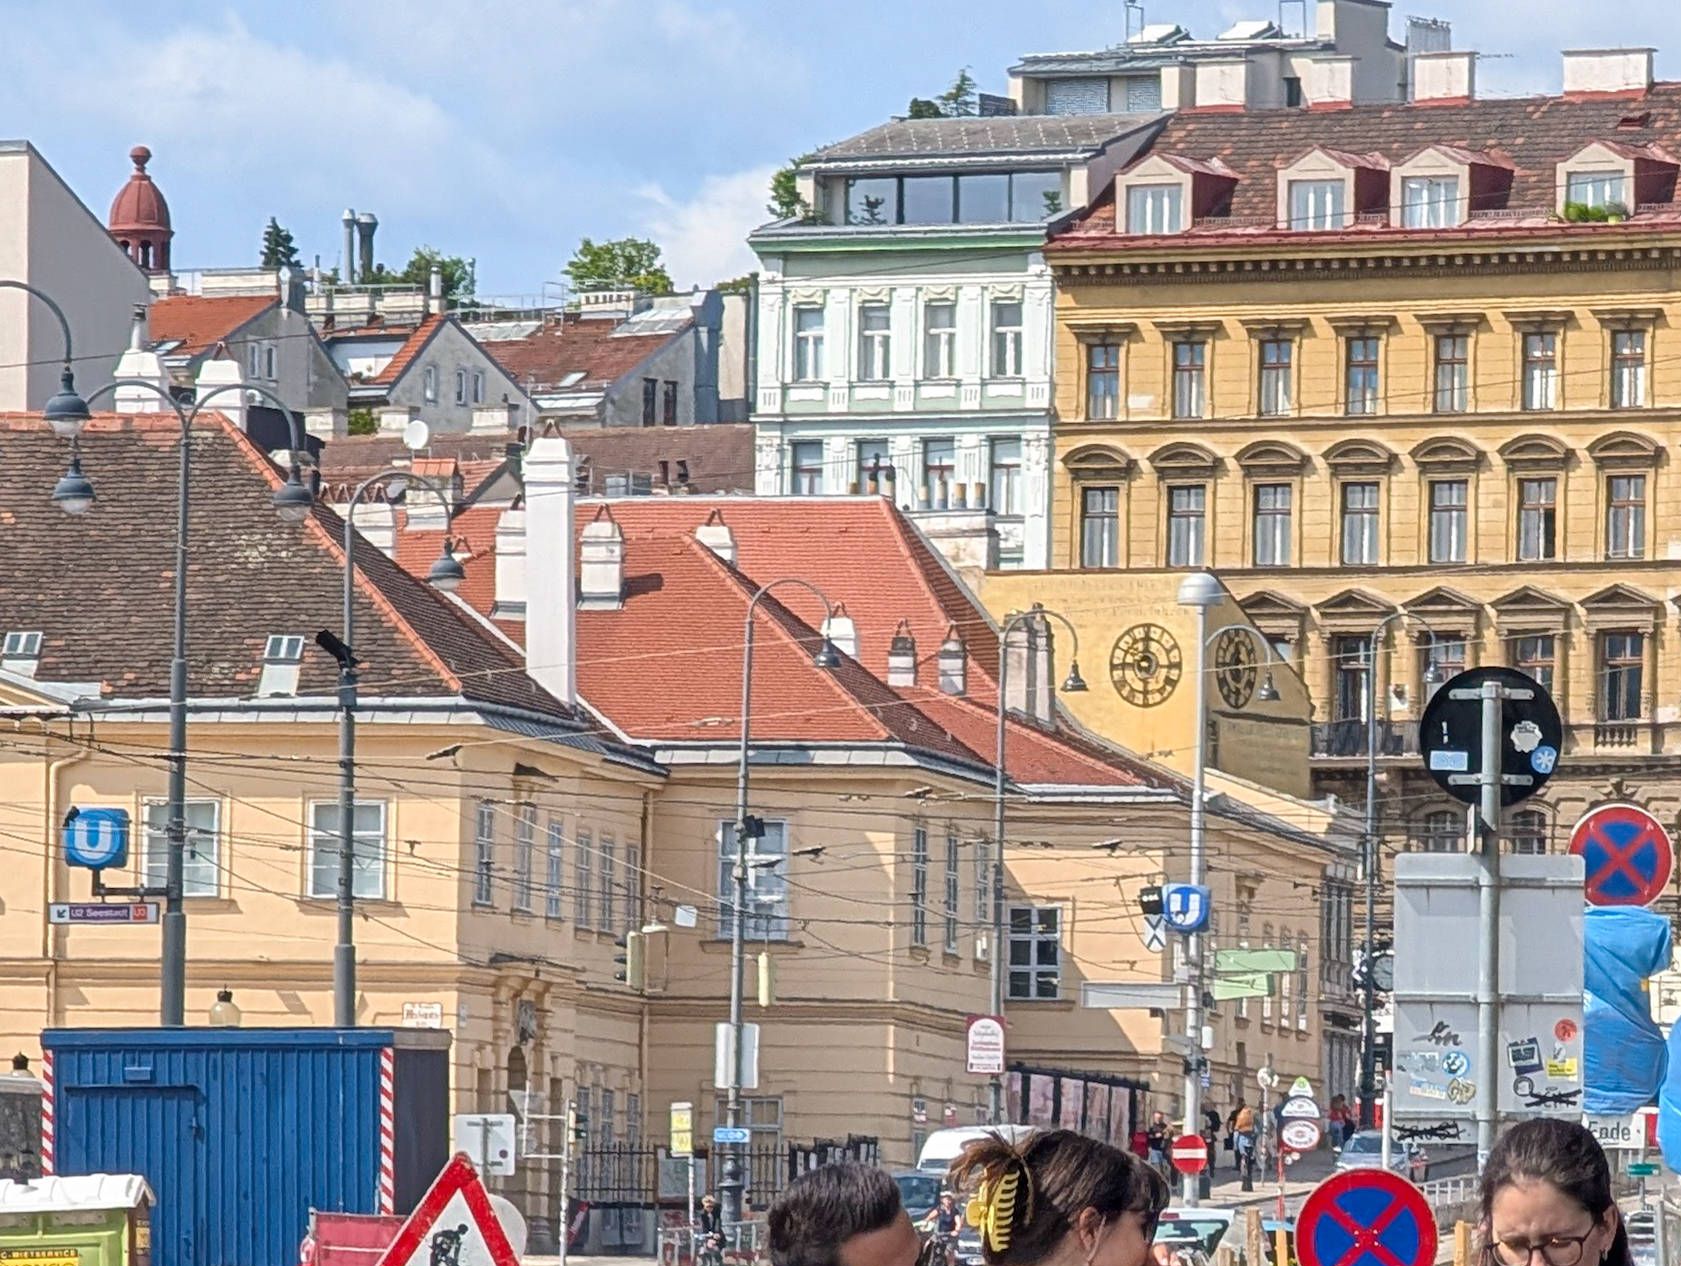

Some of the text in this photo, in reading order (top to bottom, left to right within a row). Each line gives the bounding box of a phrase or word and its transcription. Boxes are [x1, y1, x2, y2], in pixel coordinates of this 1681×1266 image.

[74, 819, 113, 861] U
[86, 908, 128, 919] Seestadt
[1169, 893, 1201, 926] U
[1588, 1120, 1631, 1142] Ende
